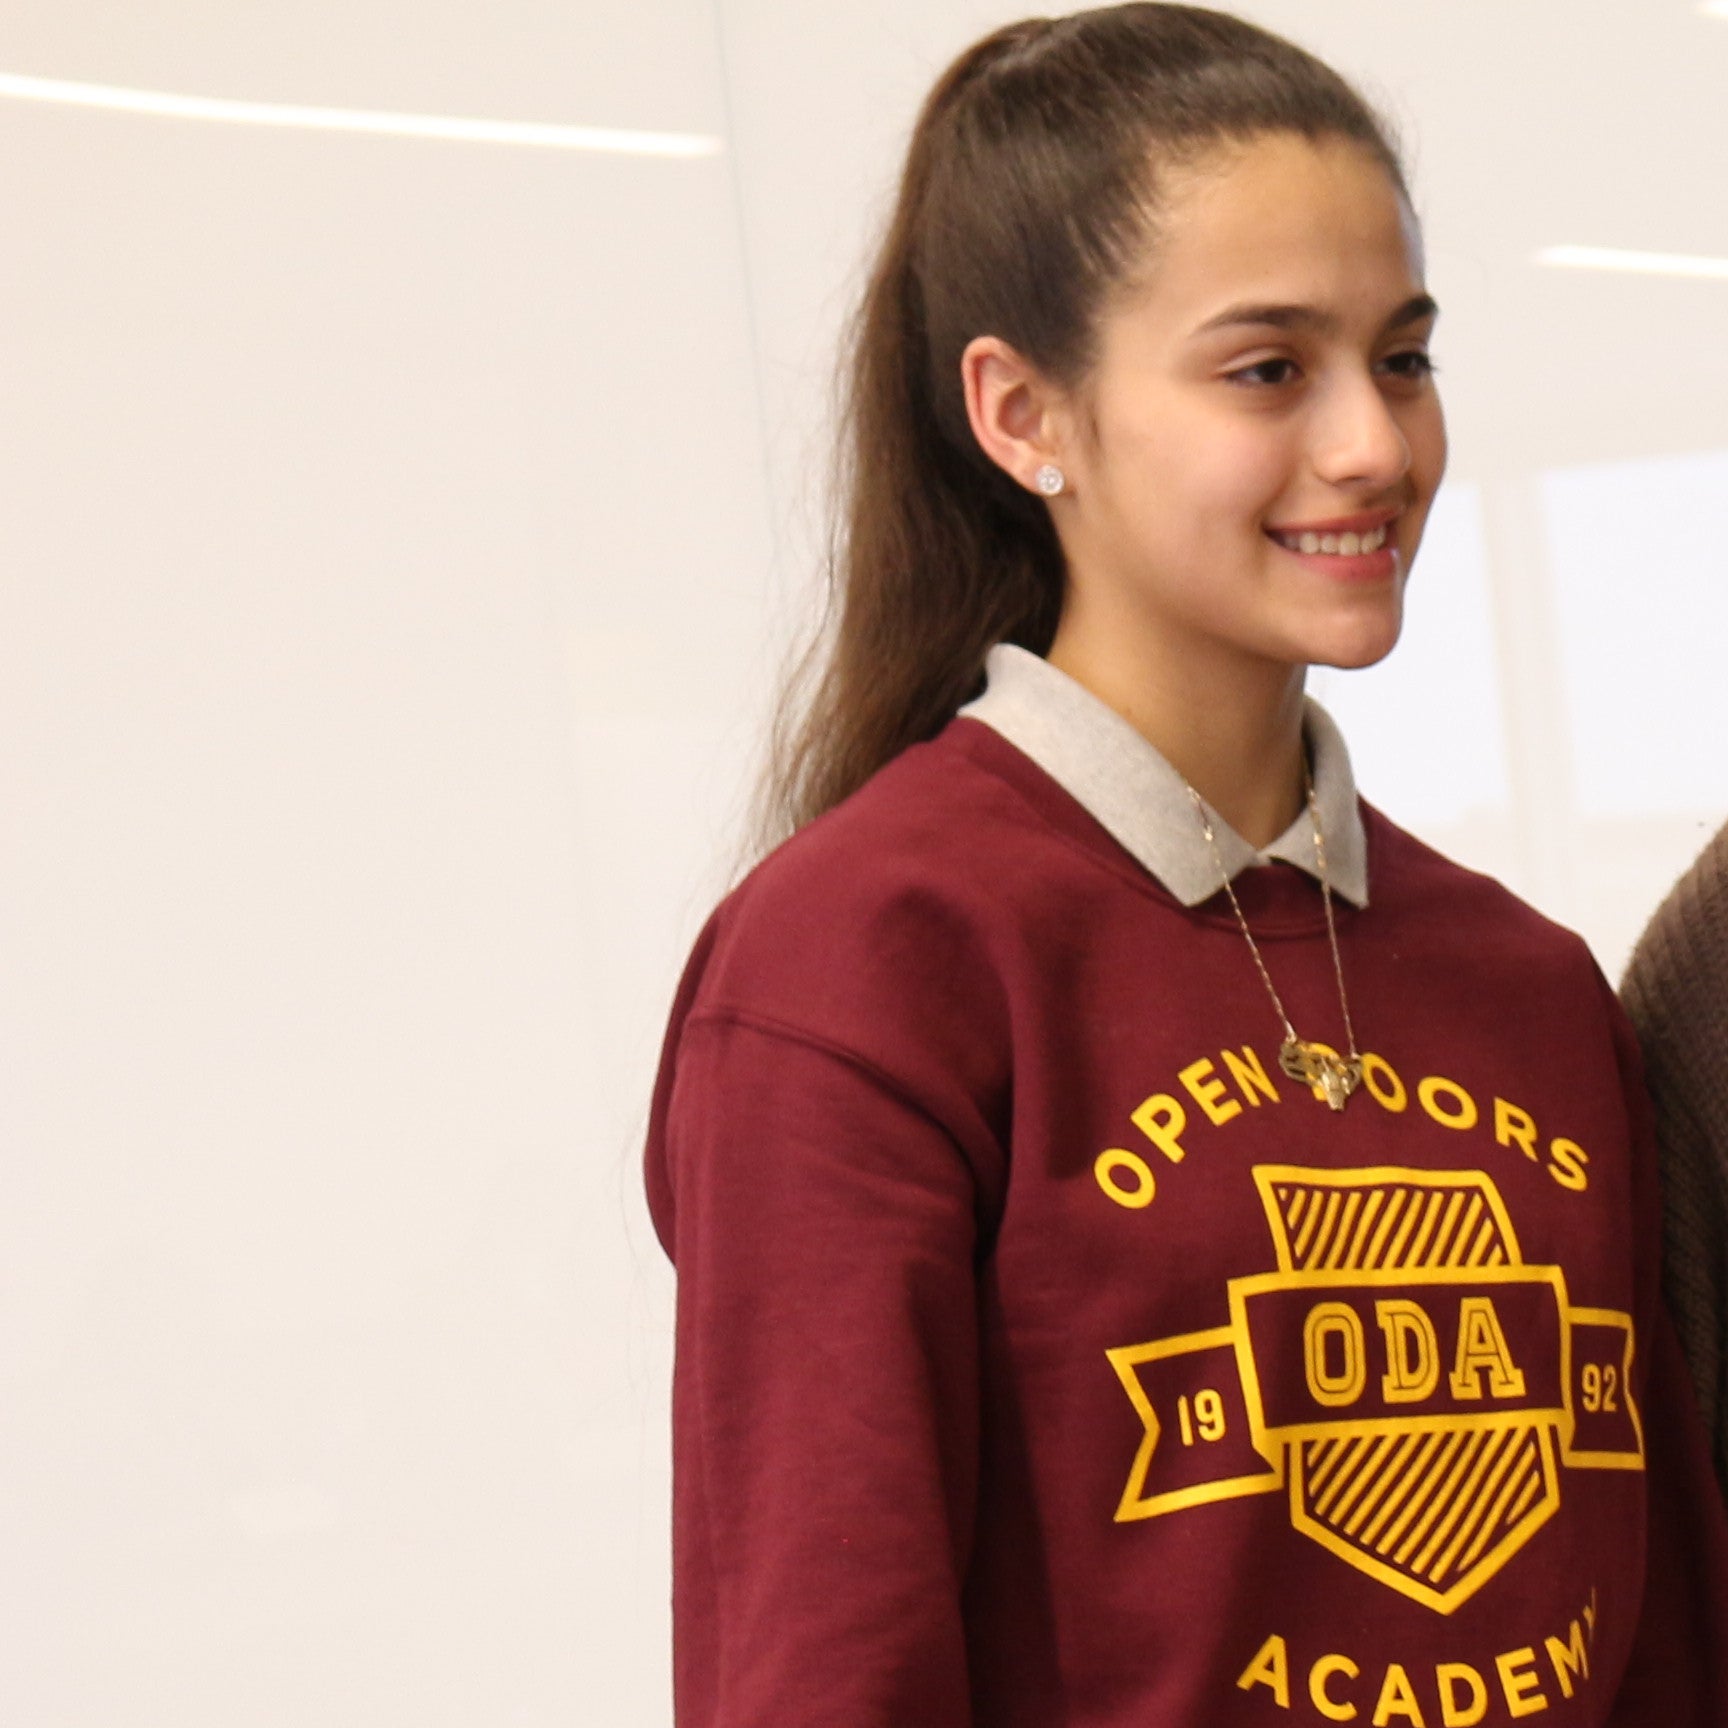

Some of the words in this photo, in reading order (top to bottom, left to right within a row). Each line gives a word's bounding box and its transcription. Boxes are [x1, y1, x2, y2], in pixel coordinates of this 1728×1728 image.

[1094, 1043, 1281, 1209] OPEN
[1303, 1297, 1526, 1407] ODA
[1582, 1362, 1618, 1412] 92
[1178, 1389, 1227, 1447] 19
